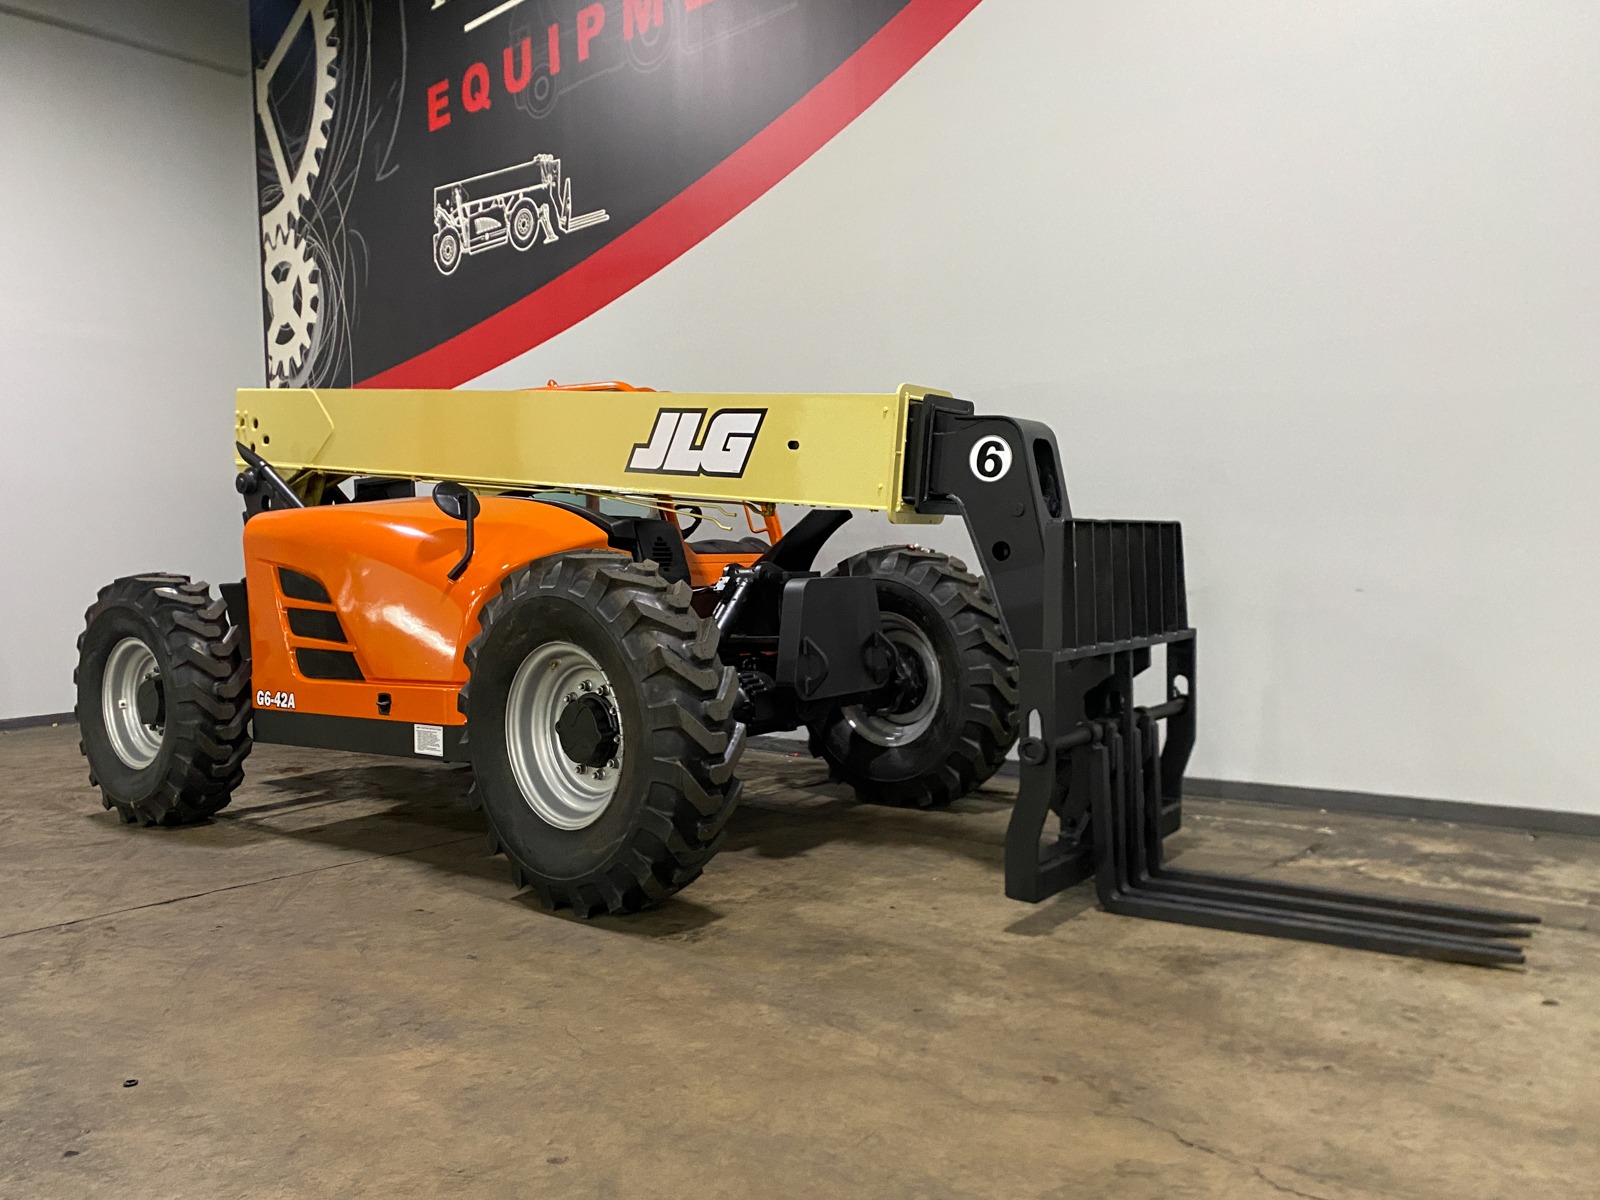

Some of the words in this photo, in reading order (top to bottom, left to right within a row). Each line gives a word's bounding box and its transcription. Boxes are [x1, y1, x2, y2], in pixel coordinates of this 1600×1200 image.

[427, 0, 714, 132] EQUIPM
[625, 408, 767, 477] JLG
[976, 440, 1005, 478] 6
[256, 690, 296, 709] G6-42A
